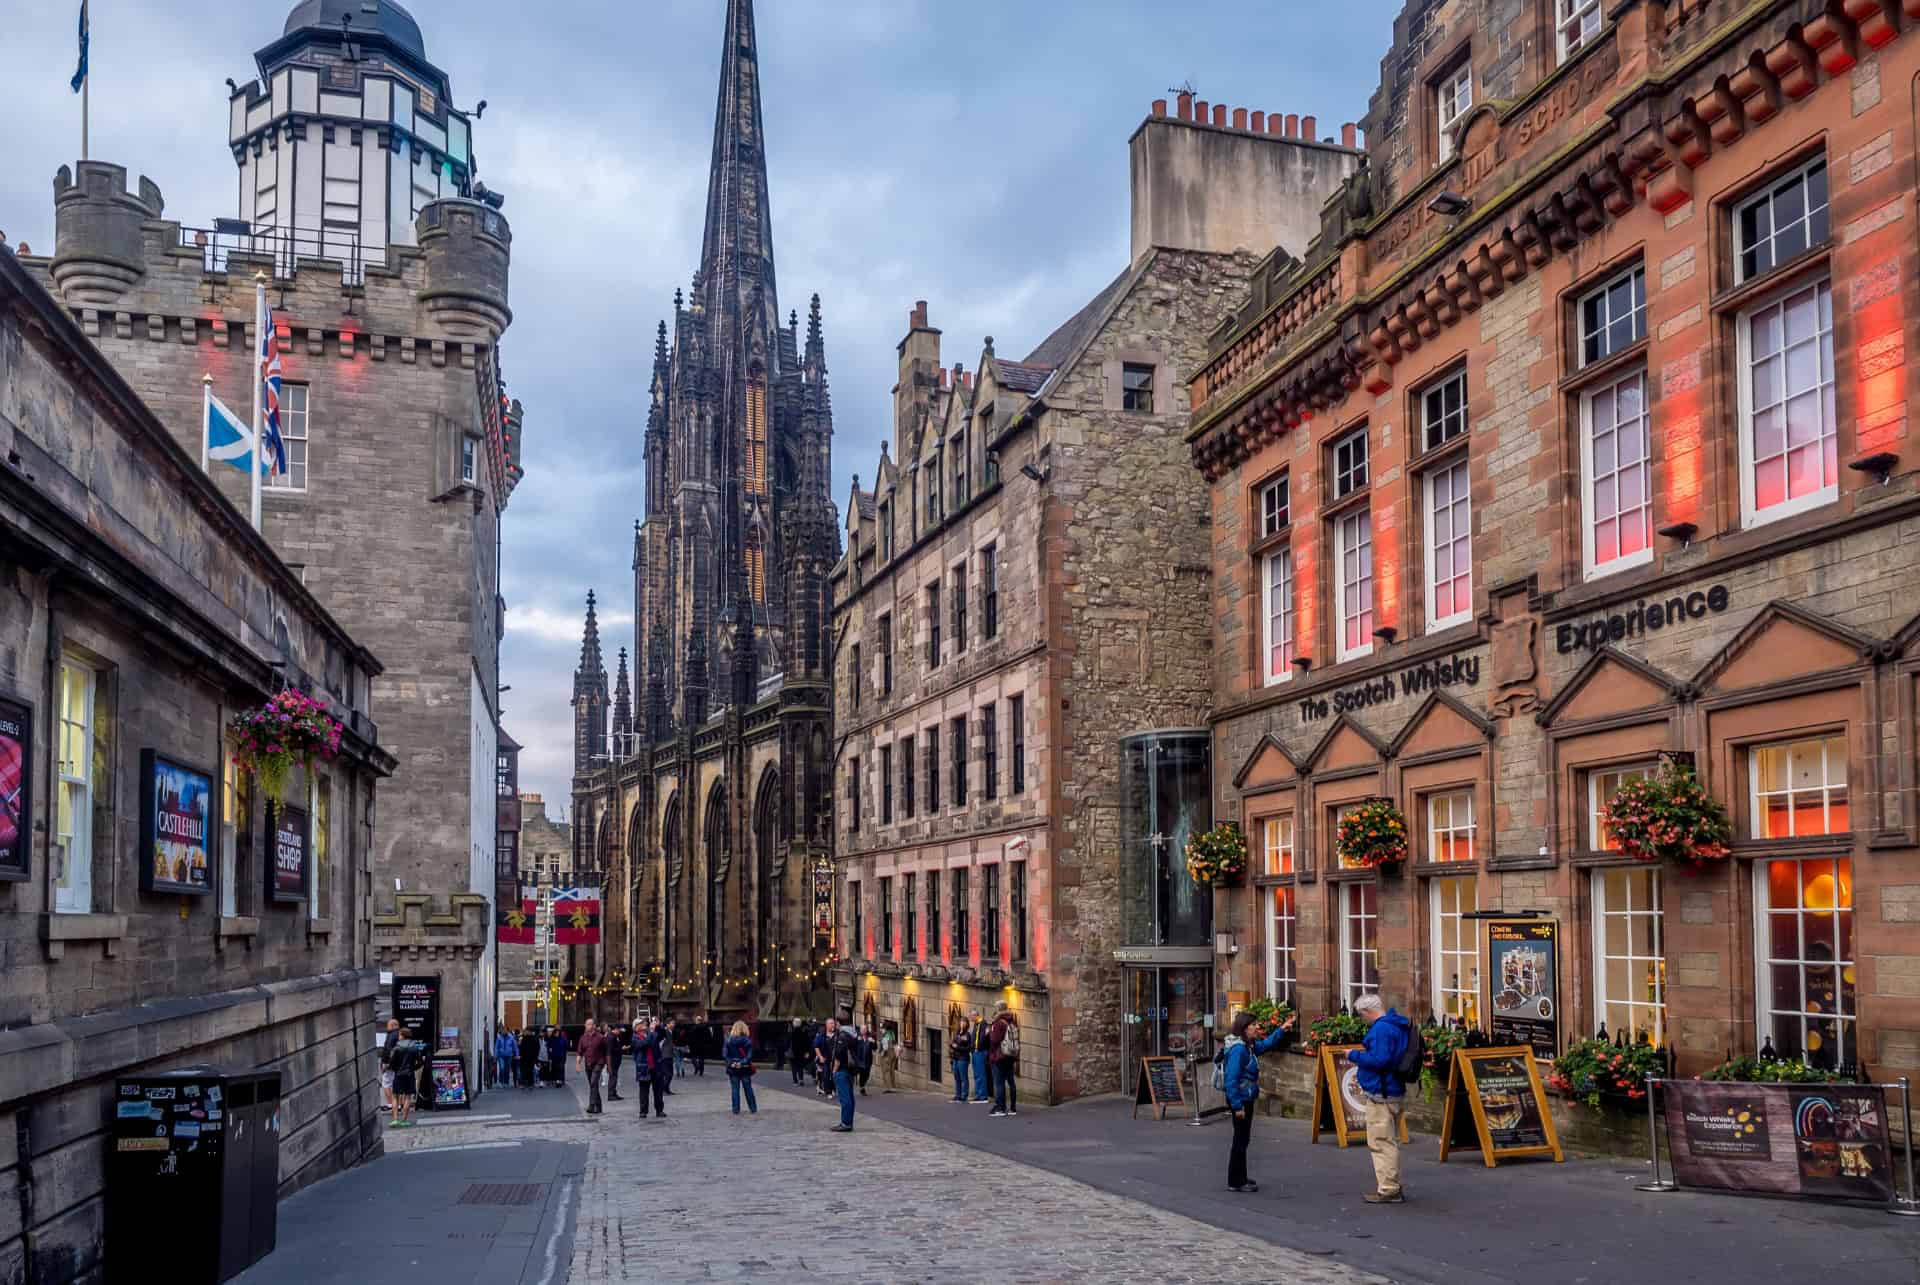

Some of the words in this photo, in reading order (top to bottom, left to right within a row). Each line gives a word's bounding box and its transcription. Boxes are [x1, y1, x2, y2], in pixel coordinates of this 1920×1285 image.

[1518, 55, 1618, 146] SCHOOL
[1299, 698, 1329, 722] The
[1333, 675, 1396, 714] Scotch
[1400, 654, 1480, 696] Whisky
[1556, 584, 1729, 655] Experience
[158, 811, 202, 840] CASTLEHILL
[278, 829, 302, 849] SCOTLAND
[277, 844, 302, 872] SHOP
